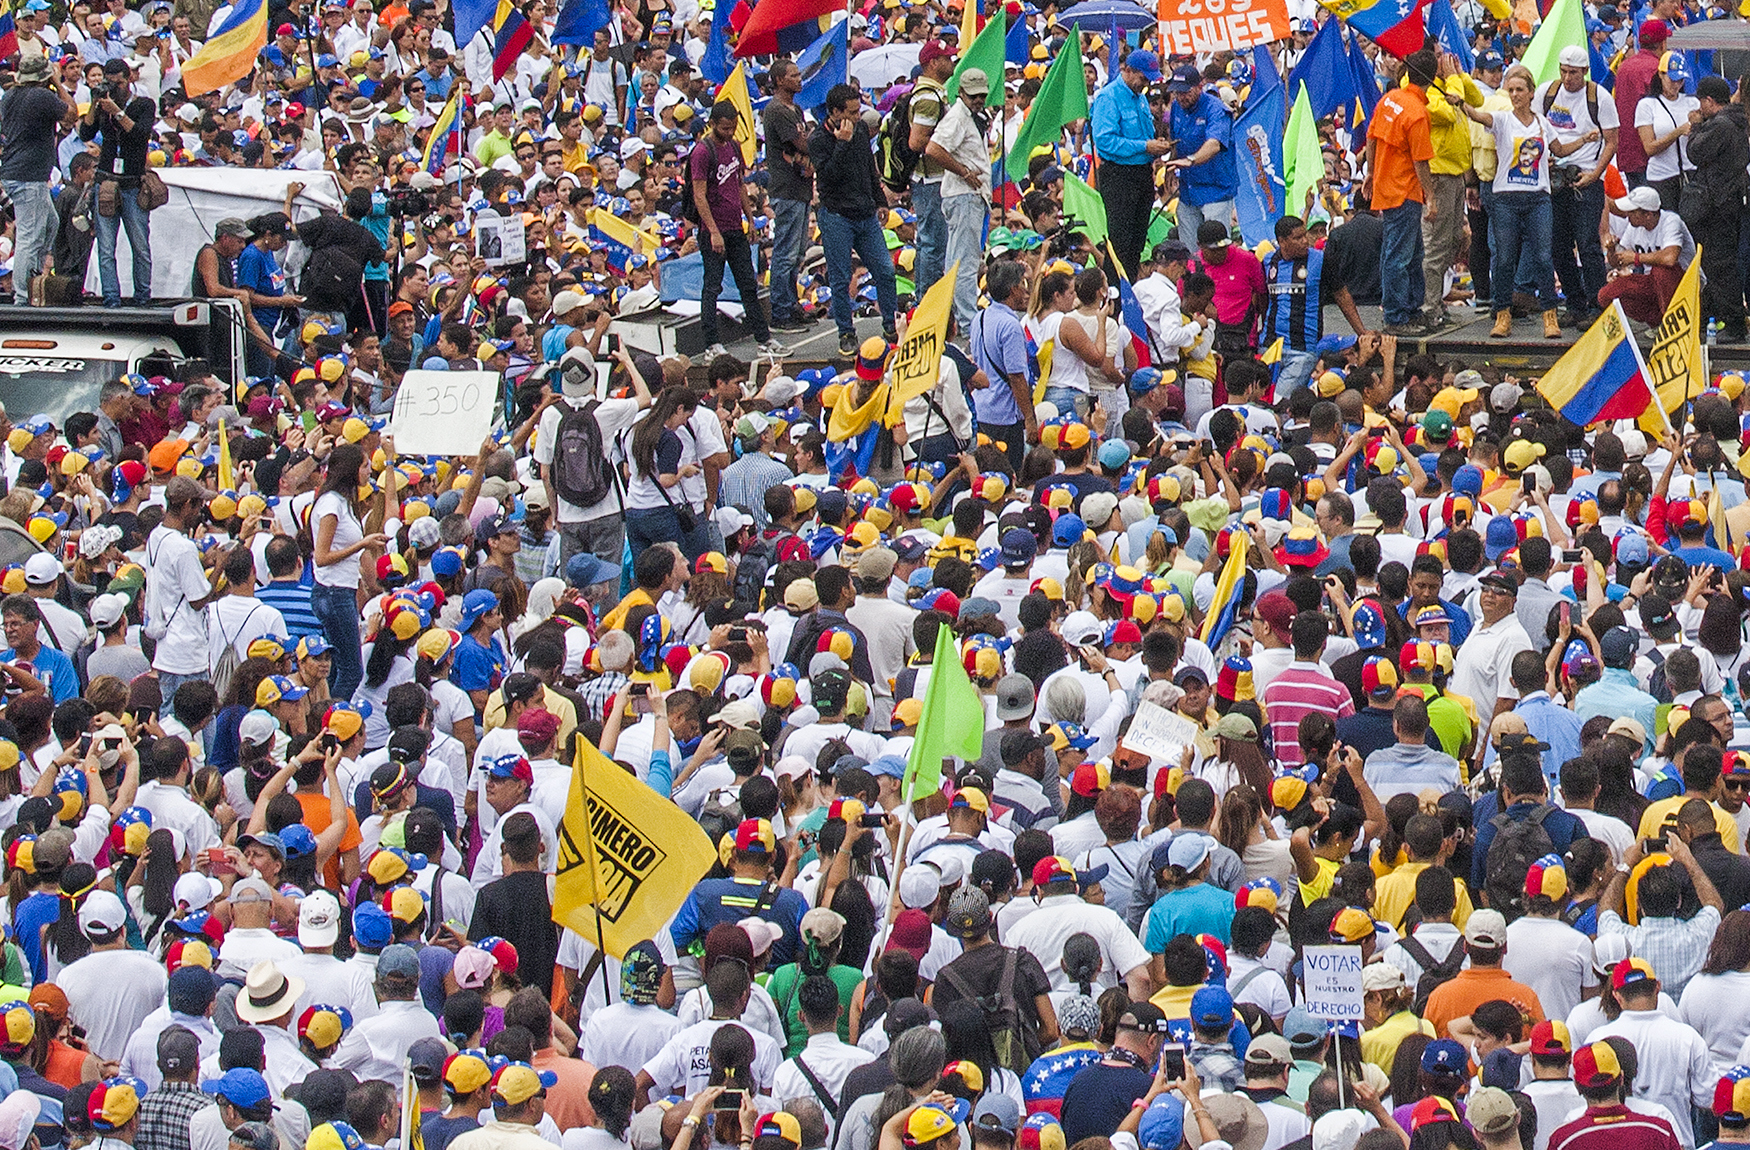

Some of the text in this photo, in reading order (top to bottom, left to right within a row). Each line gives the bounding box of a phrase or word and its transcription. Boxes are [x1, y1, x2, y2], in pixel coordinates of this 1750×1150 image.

[1159, 9, 1275, 55] TEQUES
[0, 358, 86, 371] ICKER
[585, 794, 656, 873] RIMERO
[1306, 954, 1362, 972] VOTAR
[1326, 976, 1339, 985] ES
[1314, 985, 1355, 993] NUESTRO
[1306, 1001, 1361, 1016] DERECHO
[690, 1046, 710, 1056] PETA
[691, 1058, 711, 1071] ASA
